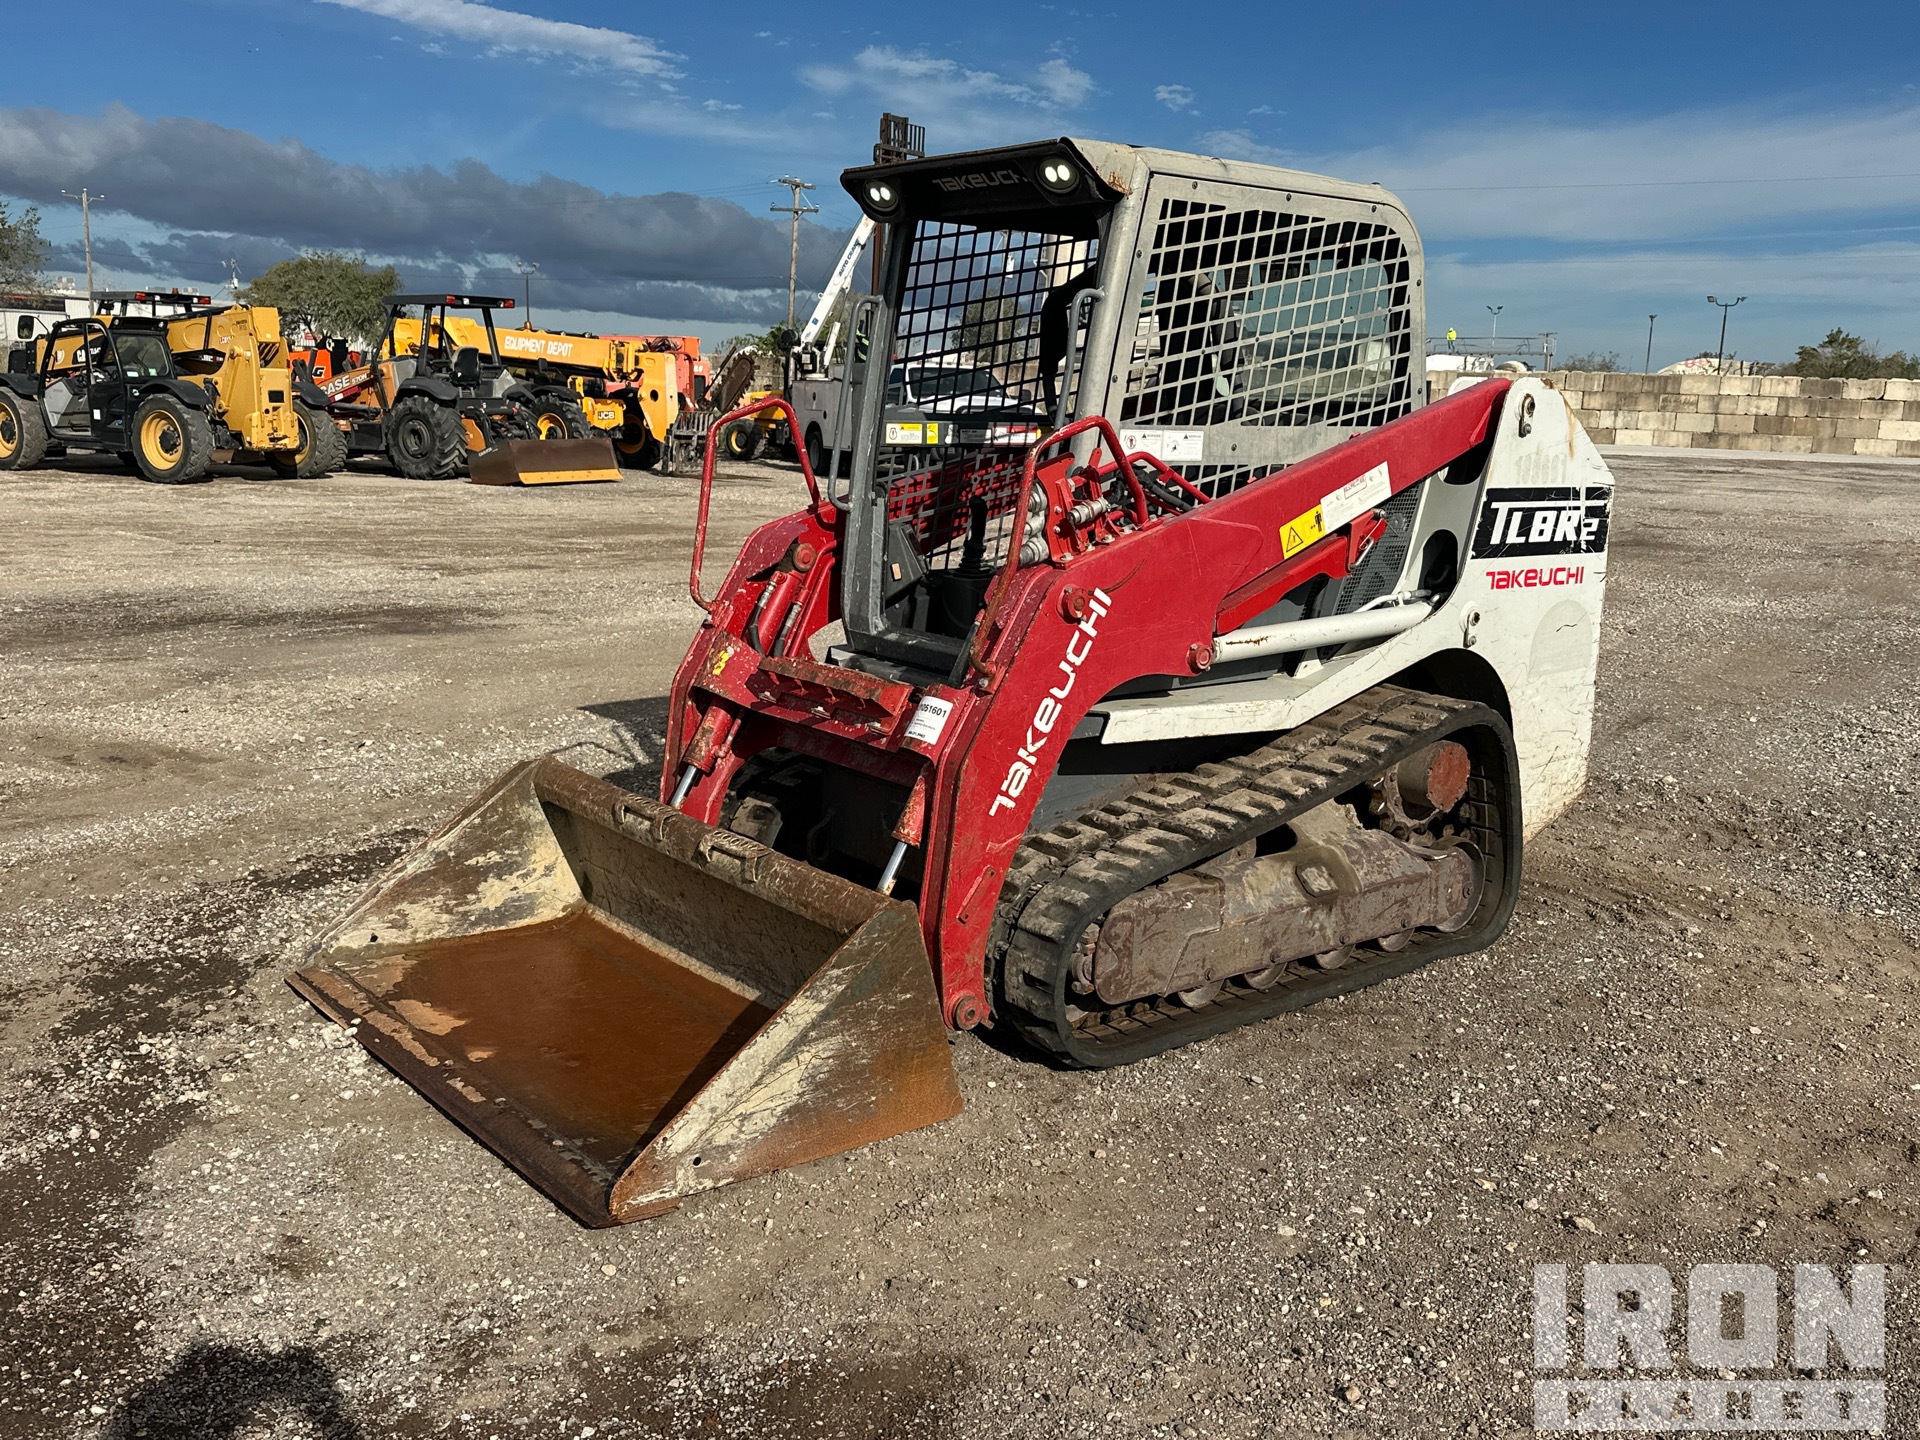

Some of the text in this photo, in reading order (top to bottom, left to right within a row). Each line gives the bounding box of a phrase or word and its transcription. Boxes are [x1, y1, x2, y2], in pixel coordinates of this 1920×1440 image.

[504, 335, 573, 358] EQUIPMENT DEPOT
[598, 411, 615, 420] JCB
[1486, 566, 1584, 590] TAKEUCHI
[989, 587, 1112, 817] TAKEUCHI
